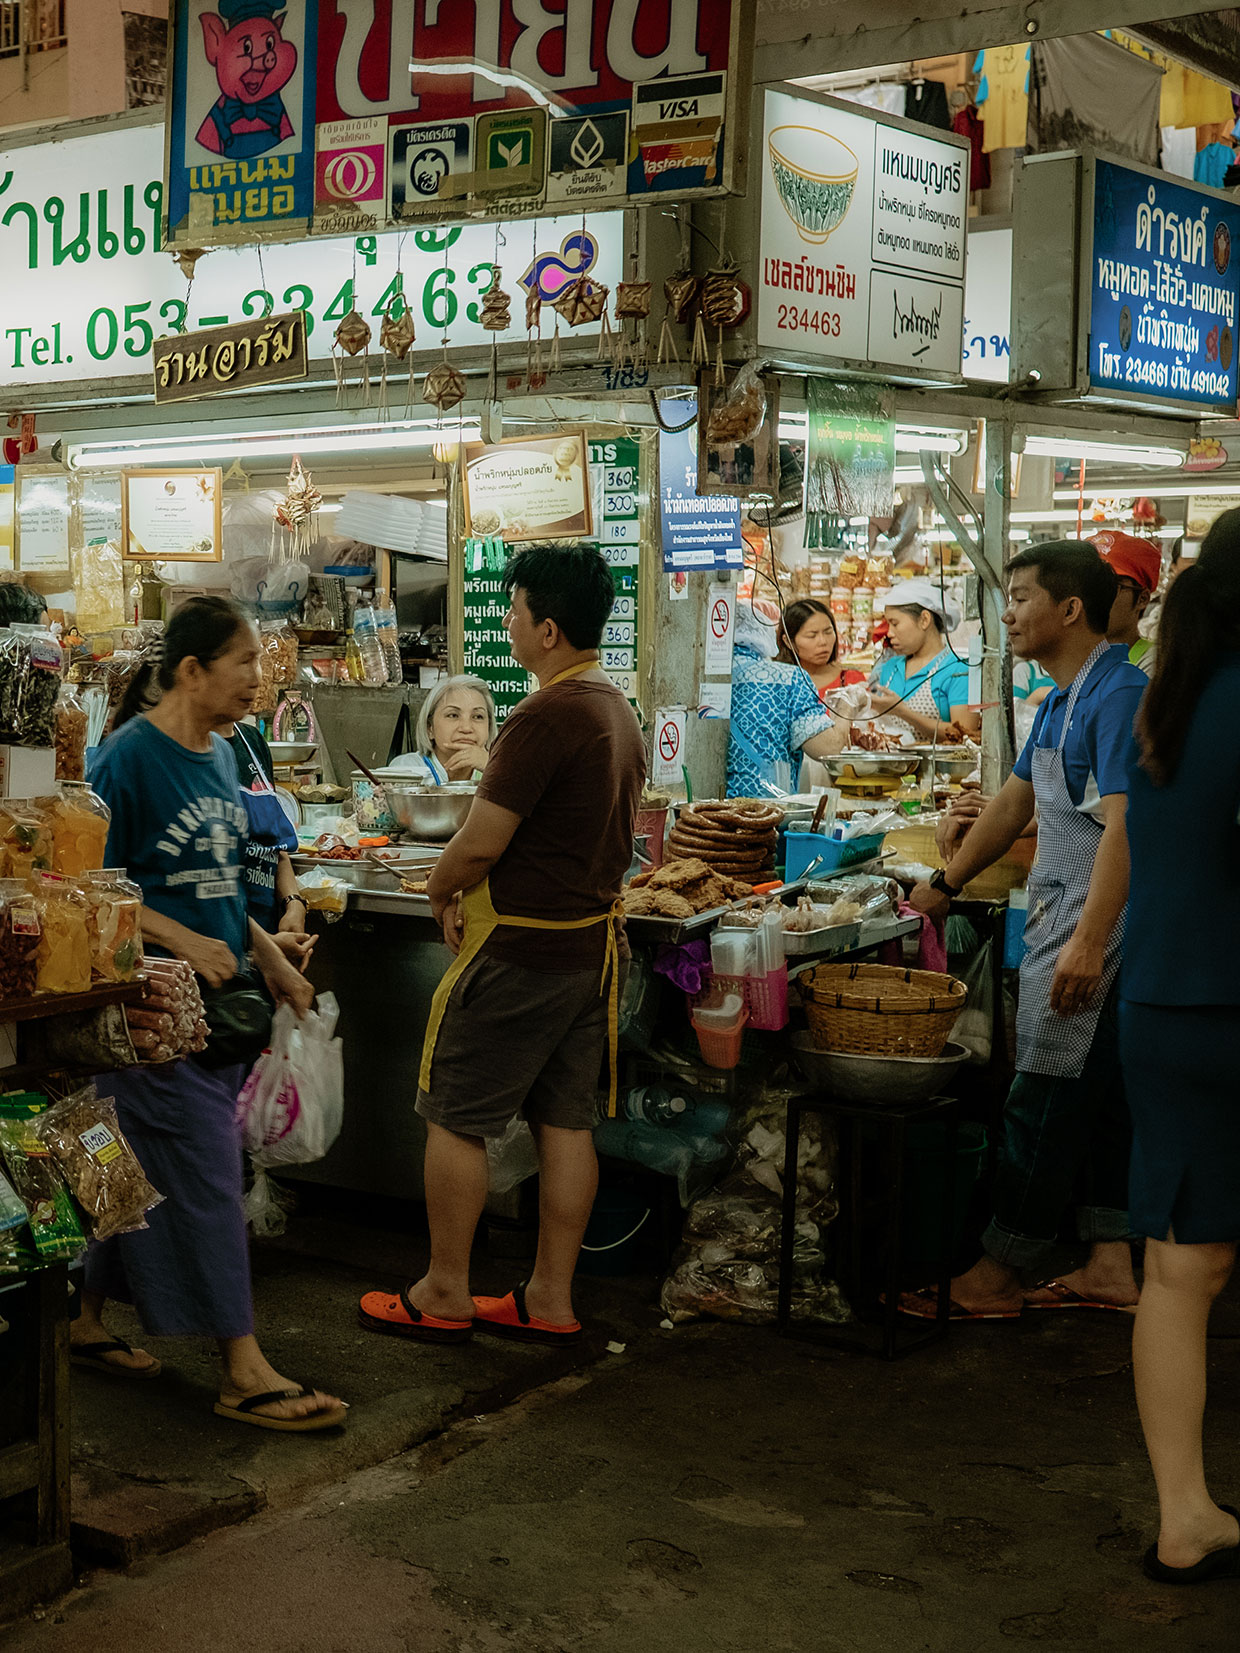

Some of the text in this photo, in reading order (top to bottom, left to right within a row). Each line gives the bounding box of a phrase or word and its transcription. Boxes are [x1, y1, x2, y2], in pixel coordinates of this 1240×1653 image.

[658, 99, 699, 121] VISA
[406, 127, 456, 144] บัตรเครดิต
[882, 148, 962, 195] แหนมบุญศรี
[878, 189, 961, 231] น้ำพริกหนุ่ม ซี่โครงหมูทอด
[1135, 184, 1210, 268] ดำรงค์
[877, 228, 911, 253] ตับหมูทอด
[944, 240, 960, 263] ไส้อั่ว
[764, 255, 856, 301] เชลล์ชวนชิม
[1098, 257, 1235, 328] หมูทอด-ไส้อั่ว-แคบหมู
[777, 303, 842, 338] 234463
[1137, 301, 1200, 364] น้ำพริกหนุ่ม
[5, 322, 73, 368] Tel.
[1098, 341, 1230, 398] โทร. 234661 บ้าน 491042
[474, 463, 553, 482] น้ำพริกหนุ่มปลอดภัย
[607, 472, 633, 486] 360
[607, 495, 632, 512] 300
[611, 526, 627, 537] 180
[605, 549, 628, 562] 200
[606, 626, 631, 642] 360
[606, 652, 629, 667] 360
